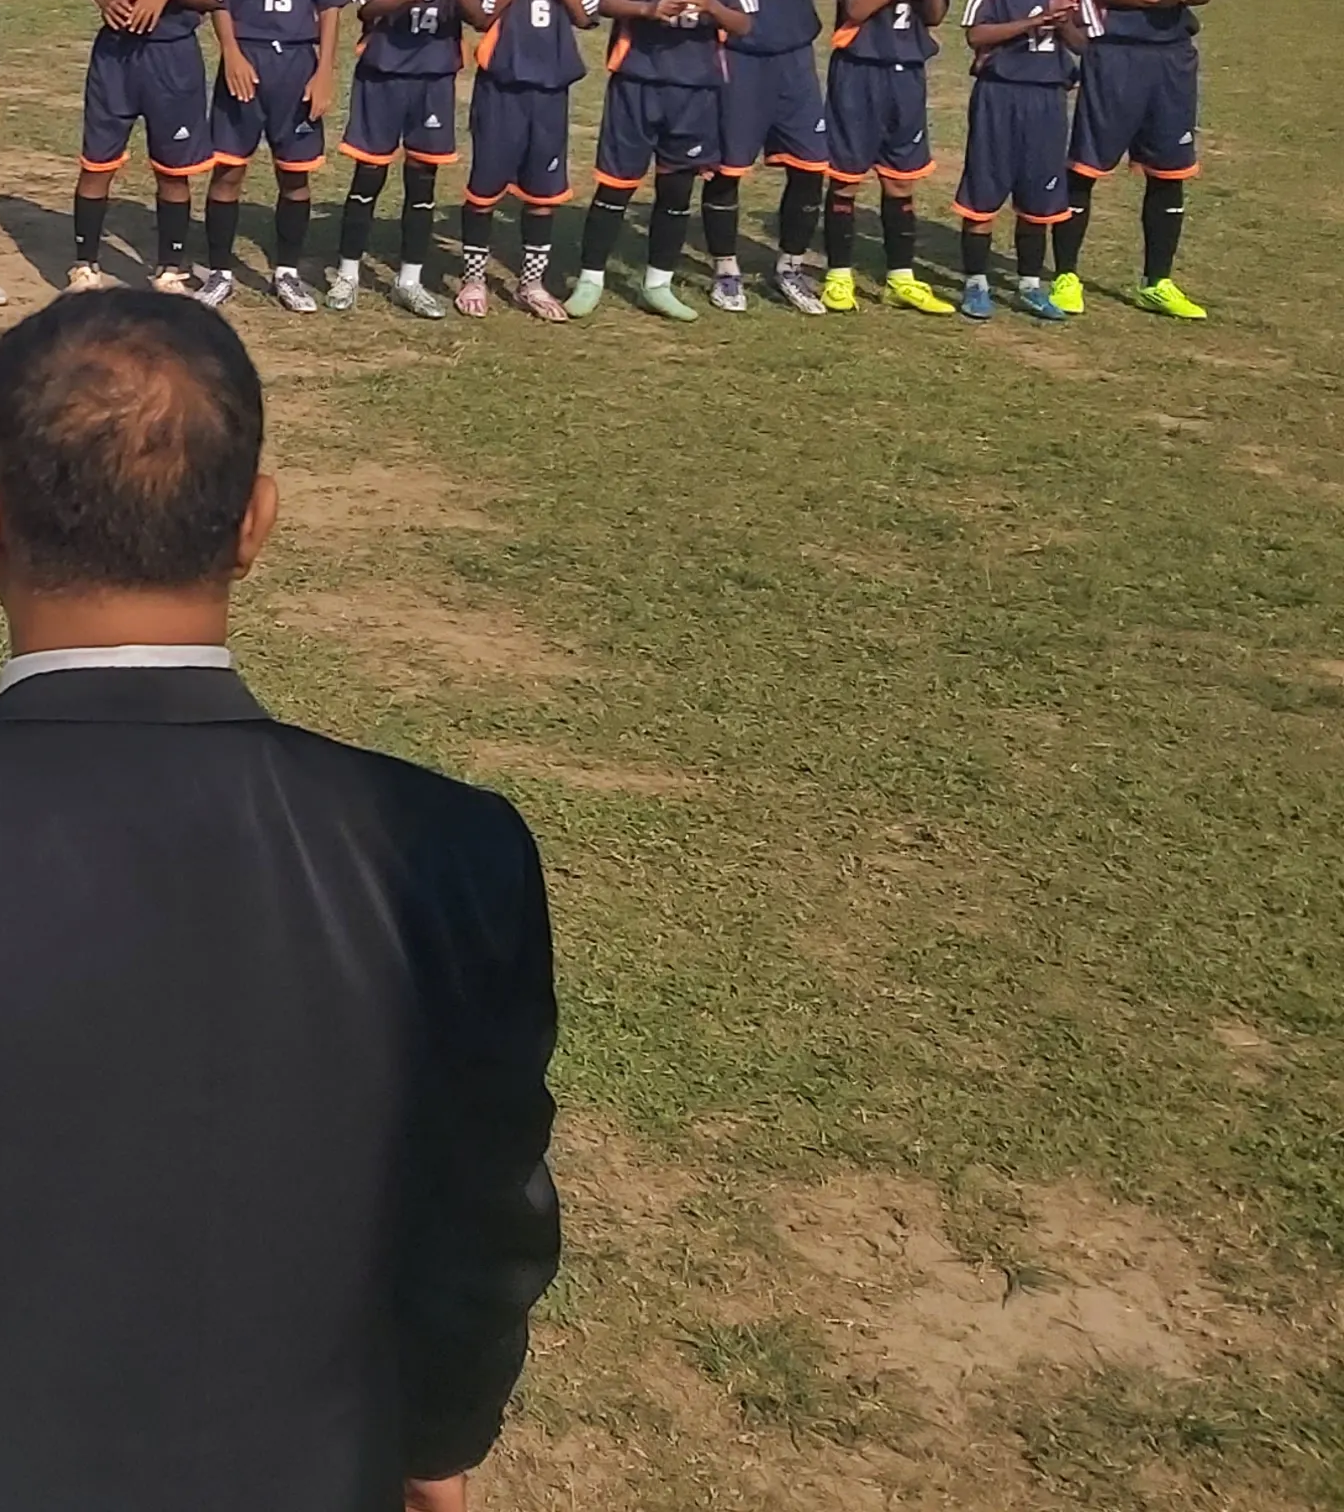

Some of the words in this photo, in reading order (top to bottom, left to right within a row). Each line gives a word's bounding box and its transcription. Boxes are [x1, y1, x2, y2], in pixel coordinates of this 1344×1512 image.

[410, 7, 438, 34] 14
[530, 0, 550, 27] 6
[893, 3, 910, 29] 2
